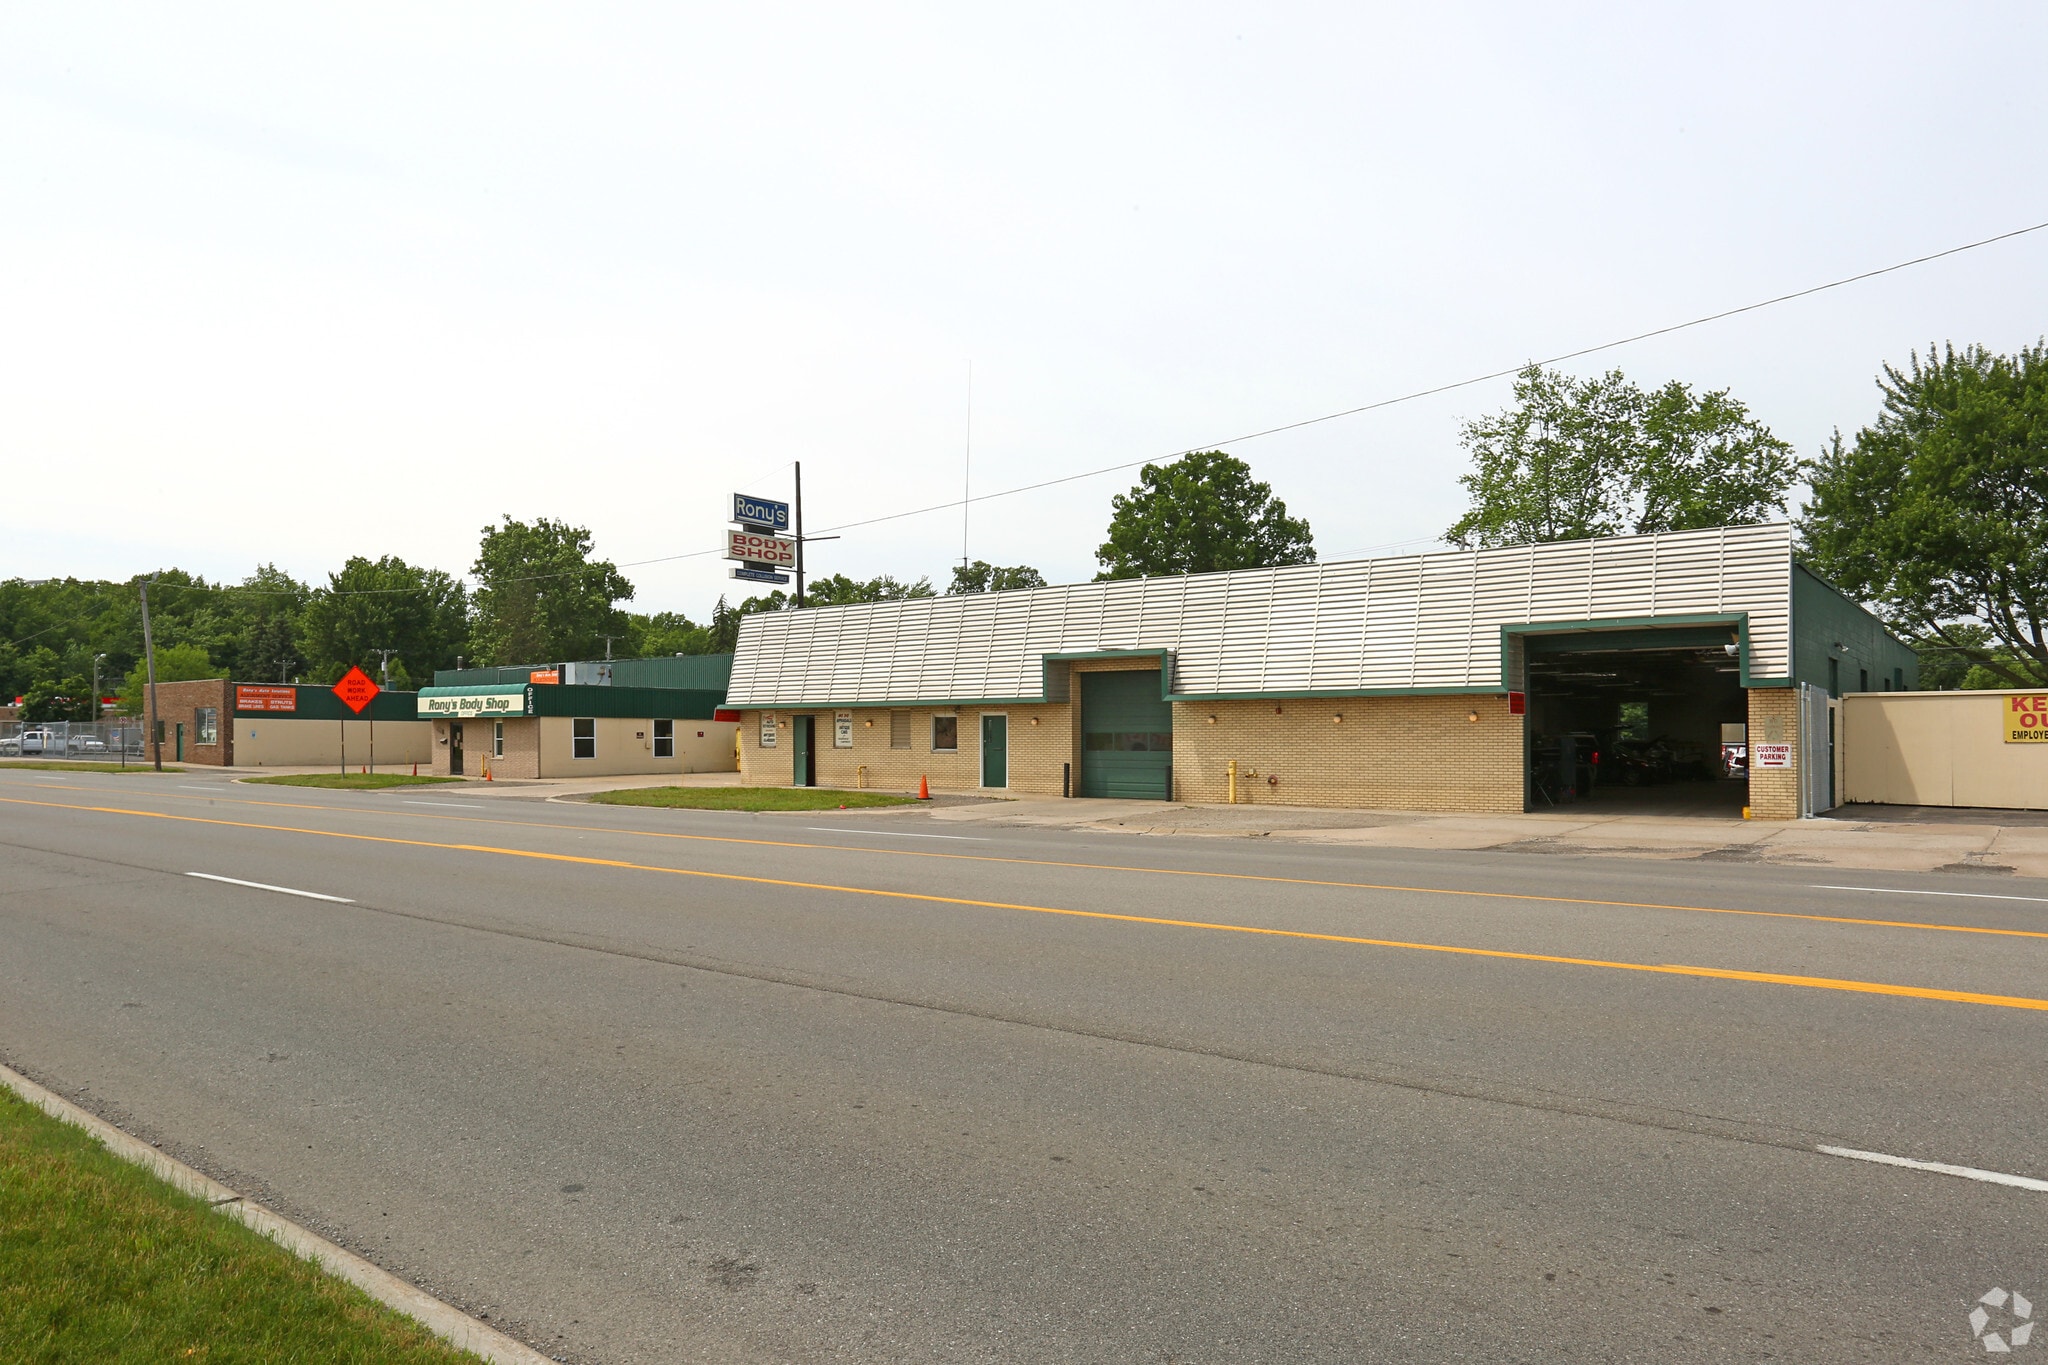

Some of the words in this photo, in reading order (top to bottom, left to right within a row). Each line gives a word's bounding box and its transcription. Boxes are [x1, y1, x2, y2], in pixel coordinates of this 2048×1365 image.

[736, 497, 786, 525] Rony's
[733, 534, 792, 551] BODY
[731, 545, 793, 562] SHOP
[428, 699, 457, 712] Rony's
[460, 698, 483, 712] Body
[485, 698, 509, 710] Shop
